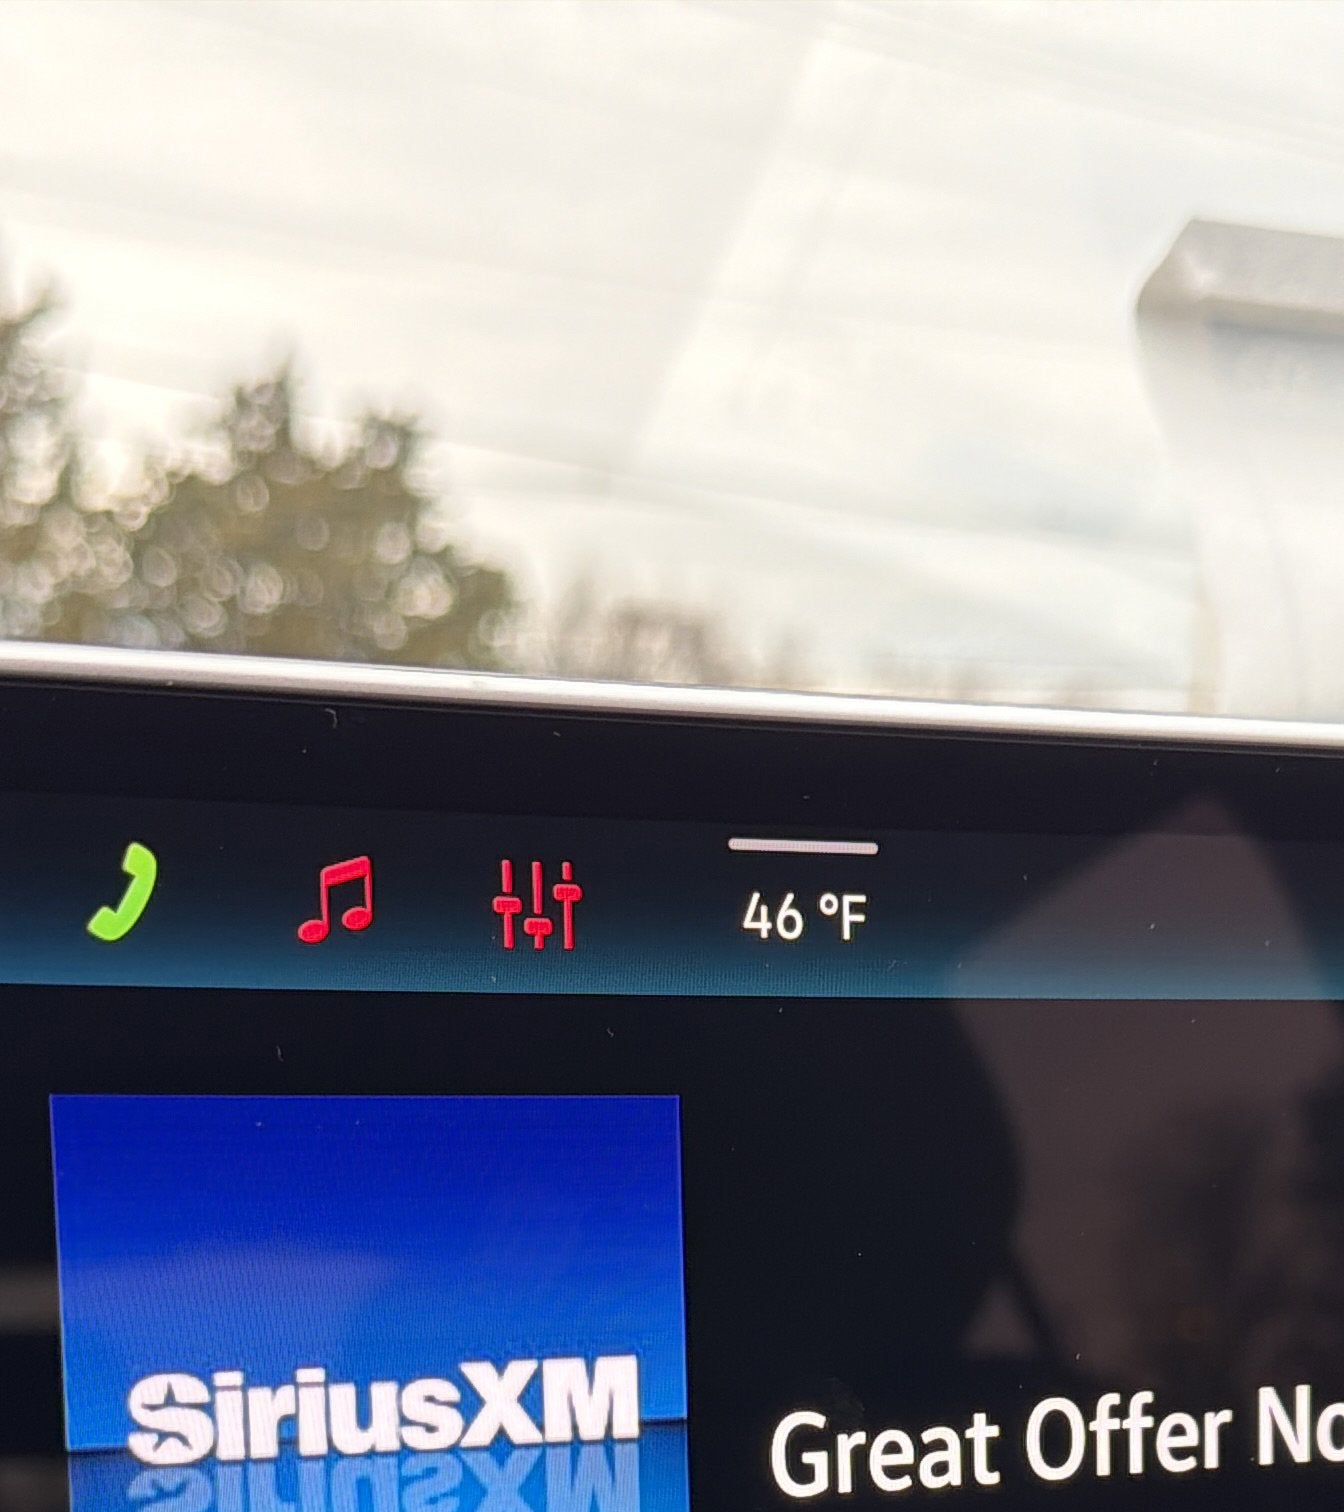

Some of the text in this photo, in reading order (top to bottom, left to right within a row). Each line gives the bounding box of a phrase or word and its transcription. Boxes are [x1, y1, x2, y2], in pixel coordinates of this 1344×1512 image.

[742, 891, 803, 941] 46
[127, 1354, 640, 1465] SiriusXM
[770, 1409, 1000, 1499] Great
[1025, 1390, 1233, 1482] Offer
